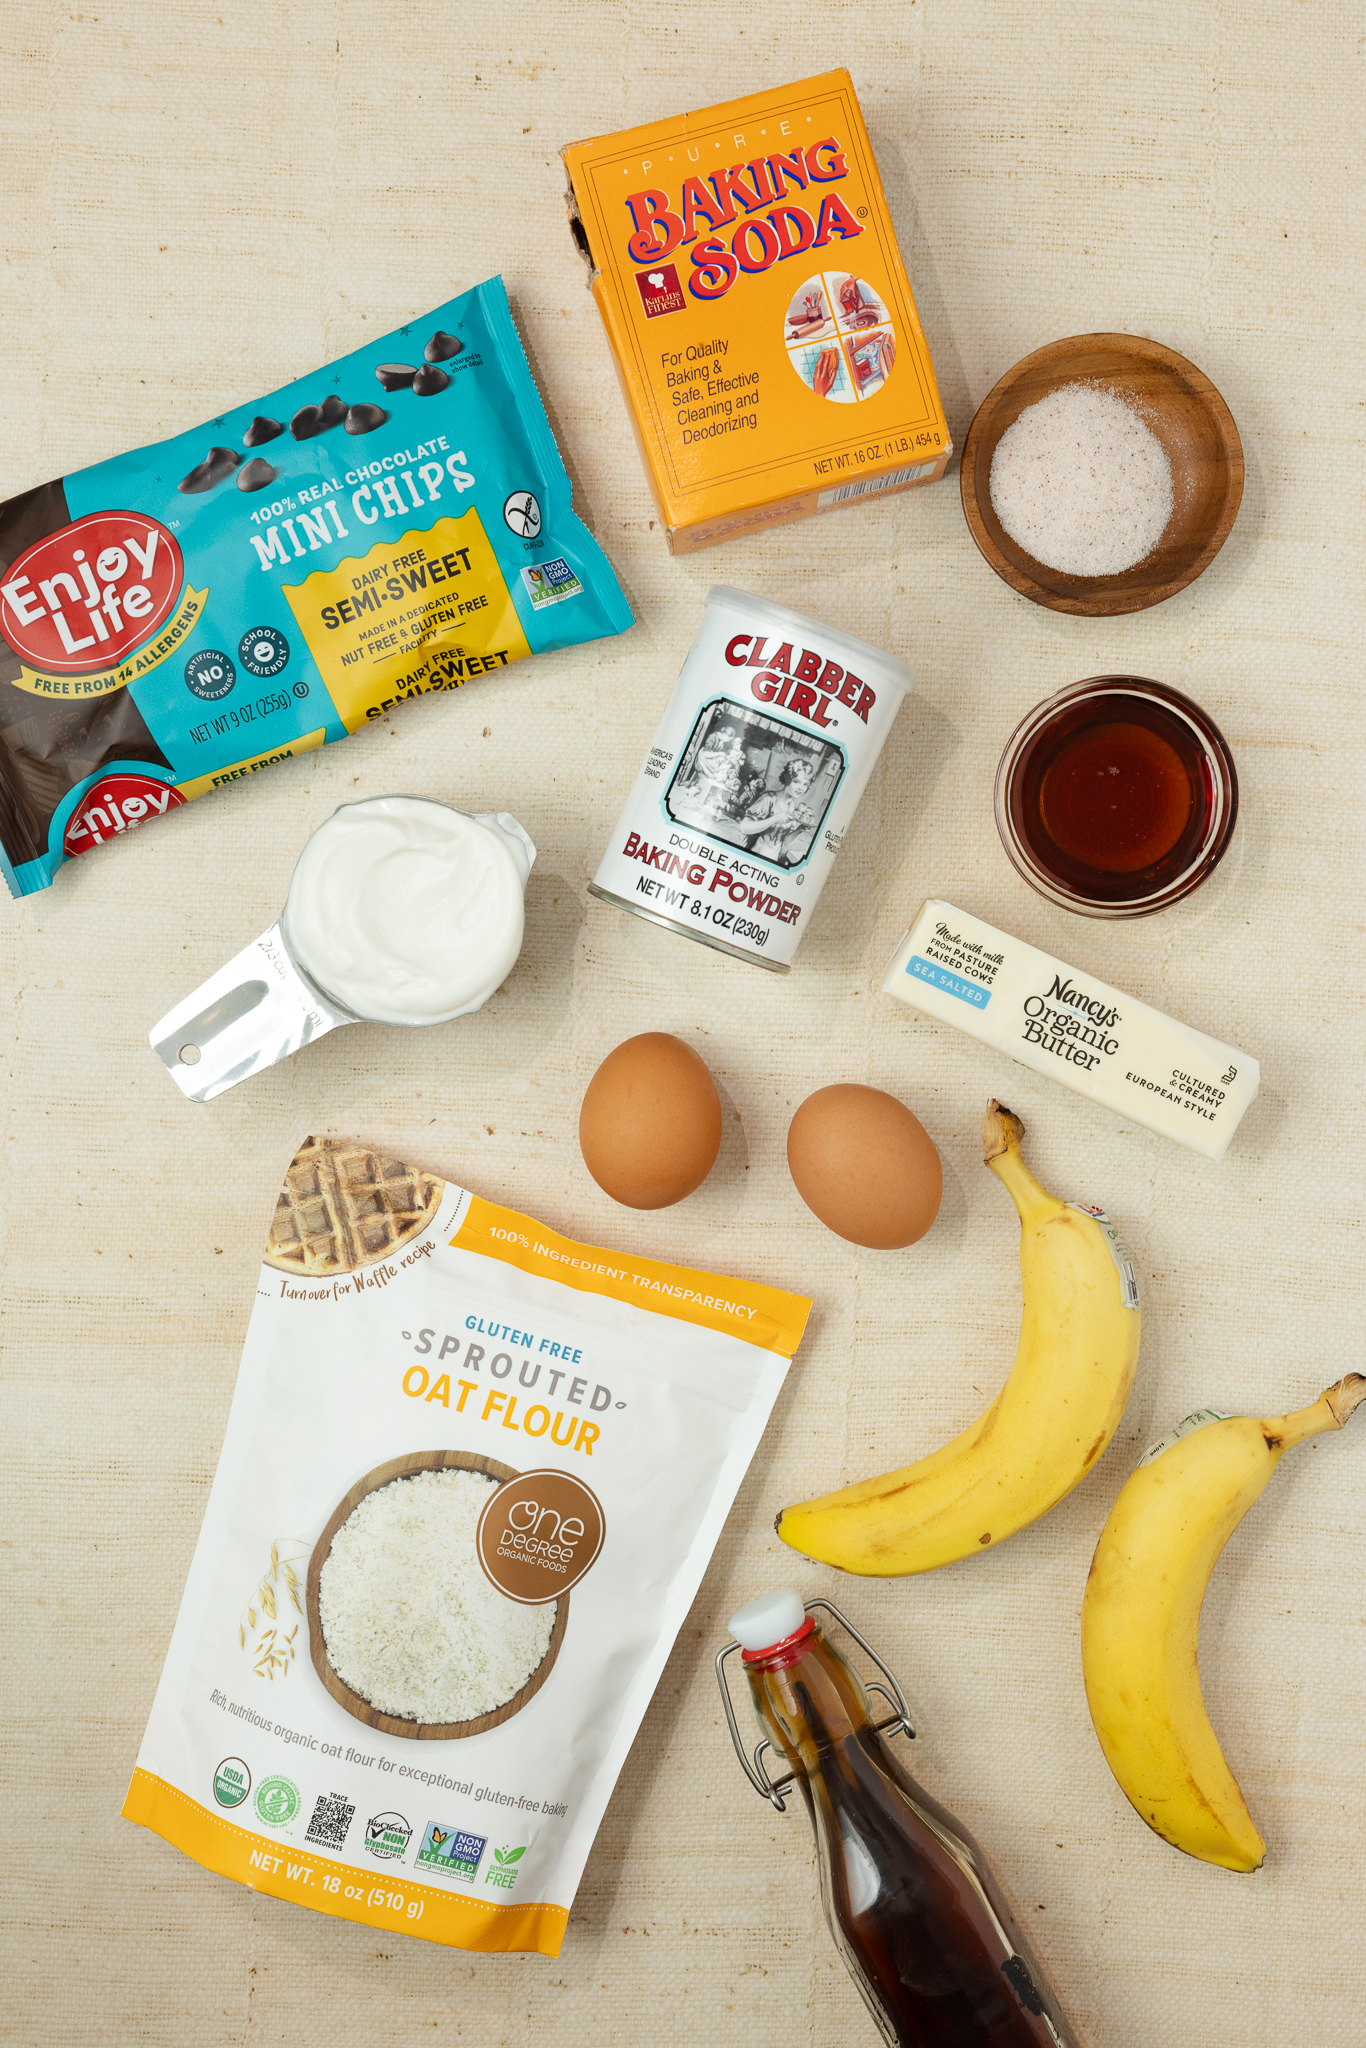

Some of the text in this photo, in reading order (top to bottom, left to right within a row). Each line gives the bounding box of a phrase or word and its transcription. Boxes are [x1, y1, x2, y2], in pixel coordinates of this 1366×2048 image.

[625, 136, 851, 264] BAKING
[689, 193, 867, 300] SODA
[449, 353, 475, 367] enlarged
[451, 359, 483, 373] show detail
[661, 339, 729, 368] For Quality
[667, 359, 723, 388] Baking &
[672, 372, 760, 407] Safe, Effective
[677, 389, 759, 426] Cleaning and
[683, 413, 758, 445] Deodorizing
[813, 432, 942, 475] NET WT. 16 OZ. (1 LB.) 454 g
[250, 435, 450, 525] 100% REAL CHOCOLATE
[249, 450, 475, 572] MINI CHIPS
[1, 529, 160, 628] Enjoy
[351, 548, 427, 591] DAIRY FREE
[545, 560, 565, 573] NON
[548, 567, 569, 580] GMO
[552, 573, 573, 585] Project
[533, 580, 577, 601] VERIFIED
[534, 586, 584, 609] nongmoproject.org
[52, 583, 154, 655] Life
[340, 594, 489, 667] NUT FREE & GLUTEN FREE
[358, 591, 459, 641] MADE IN A DEDICATED
[34, 600, 199, 694] FREE FROM 14 ALLERGENS
[241, 629, 277, 652] SCHOOL
[399, 629, 438, 655] FACILITY
[187, 652, 224, 676] ARTIFICIAL
[197, 665, 224, 686] NO
[247, 648, 287, 675] FRIENDLY
[395, 660, 432, 690] DAIRY
[431, 648, 466, 665] FREE
[193, 672, 234, 698] SWEETENERS
[725, 634, 876, 725] CLABBER
[751, 671, 832, 728] GIRL
[189, 689, 292, 745] NET WT 9 OZ (255g)
[211, 750, 294, 787] FREE FROM
[644, 766, 661, 779] BRAND
[669, 833, 780, 888] DOUBLE ACTING
[623, 831, 802, 926] BAKING POWDER
[636, 875, 770, 947] NET WT 8.1 OZ (230g)
[930, 937, 999, 976] FROM PASTURE
[935, 922, 1005, 965] Made with milk
[257, 940, 292, 982] 2/3 cup
[925, 946, 994, 985] RAISED COWS
[914, 962, 983, 1002] SEA SALTED
[1042, 974, 1120, 1027] Nancy's
[1023, 995, 1119, 1055] Organic
[1021, 1018, 1101, 1071] Butter
[1125, 1071, 1217, 1121] EUROPEAN STYLE
[1169, 1079, 1222, 1108] & CREAMY
[1172, 1069, 1226, 1100] CULTURED
[280, 1240, 436, 1301] Turn over for Waffle recipe
[489, 1226, 758, 1320] 100% INGREDIENT TRANSPARENCY
[465, 1315, 583, 1364] GLUTEN FREE
[413, 1328, 613, 1412] SPROUTED
[402, 1365, 601, 1456] OAT FLOUR
[1149, 1442, 1165, 1456] 94011
[496, 1546, 568, 1574] ORGANIC FOODS
[209, 1688, 569, 1818] Rich, nutritious organic oat flour for exceptional gluten-free baking
[216, 1779, 242, 1798] ORGANIC
[223, 1766, 244, 1785] USDA
[261, 1782, 295, 1805] BEYOND CELIAC
[330, 1792, 348, 1802] TRACE
[258, 1800, 290, 1821] GLUTEN-FREE
[304, 1834, 343, 1852] INGREDIENTS
[367, 1818, 413, 1836] BioChecked
[382, 1831, 406, 1845] NON
[458, 1834, 483, 1848] NON
[364, 1838, 406, 1855] Glyphosate
[365, 1846, 402, 1860] CERTIFIED
[422, 1851, 474, 1872] VERIFIED
[452, 1851, 477, 1863] Project
[455, 1843, 480, 1856] GMO
[249, 1849, 424, 1920] NET WT. 18 oz (510 g)
[416, 1860, 474, 1880] nongmoproject.org
[485, 1870, 517, 1889] FREE
[489, 1864, 519, 1875] GLYPHOSATE
